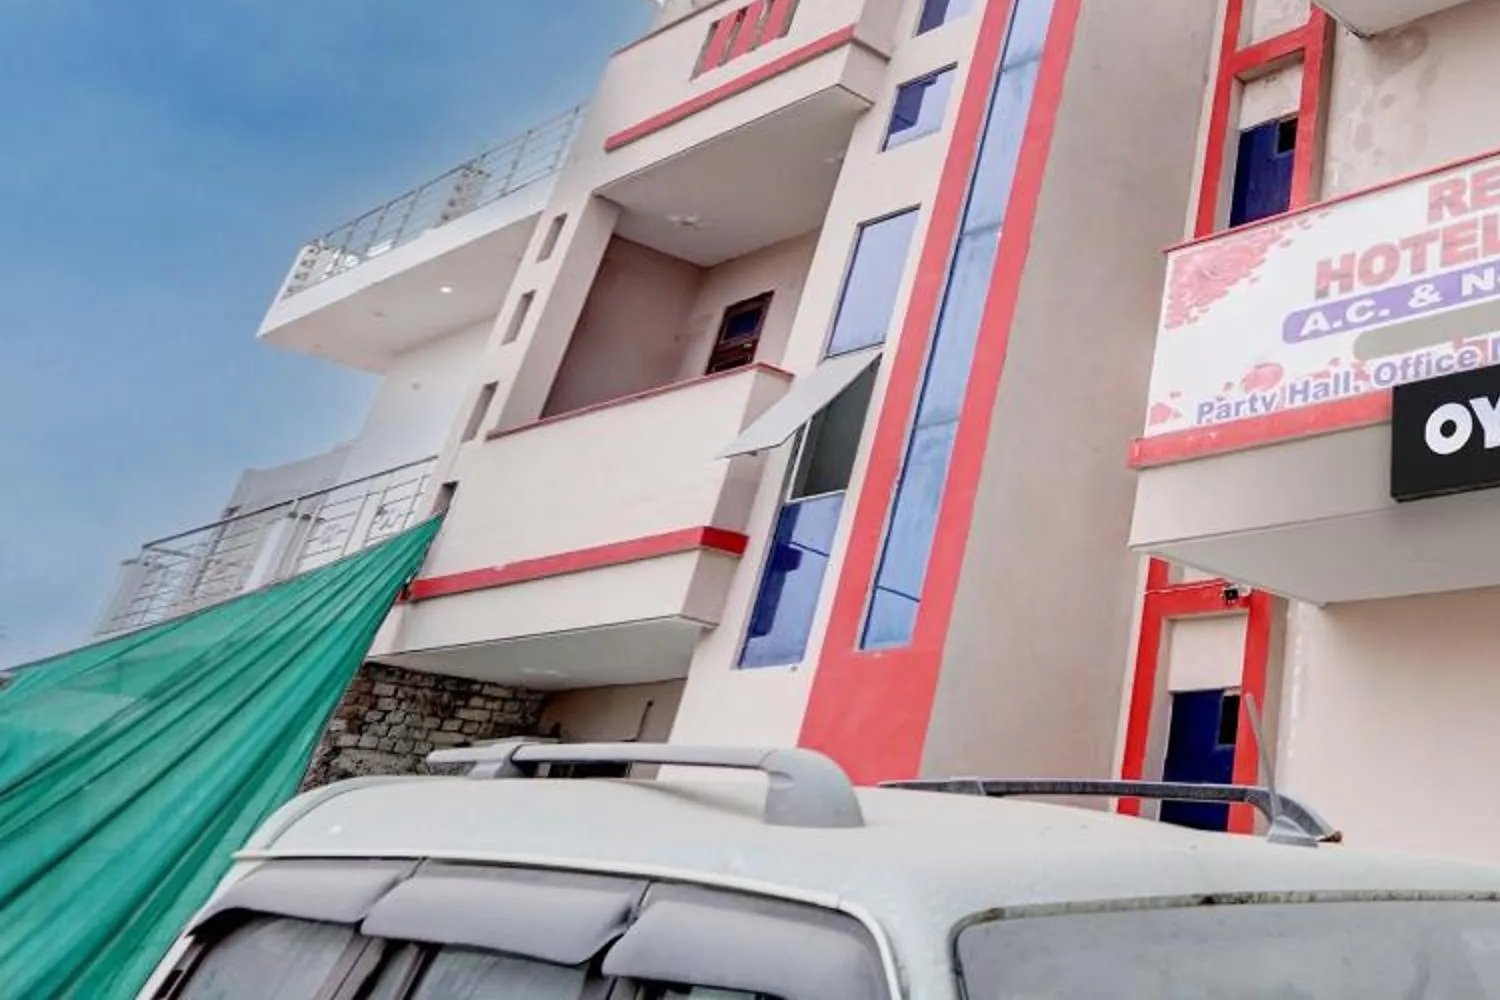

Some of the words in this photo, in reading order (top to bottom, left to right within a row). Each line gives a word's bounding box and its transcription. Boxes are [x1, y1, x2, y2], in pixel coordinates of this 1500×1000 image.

[1299, 298, 1391, 338] A.C.
[1407, 284, 1444, 308] &
[1373, 346, 1478, 386] Office
